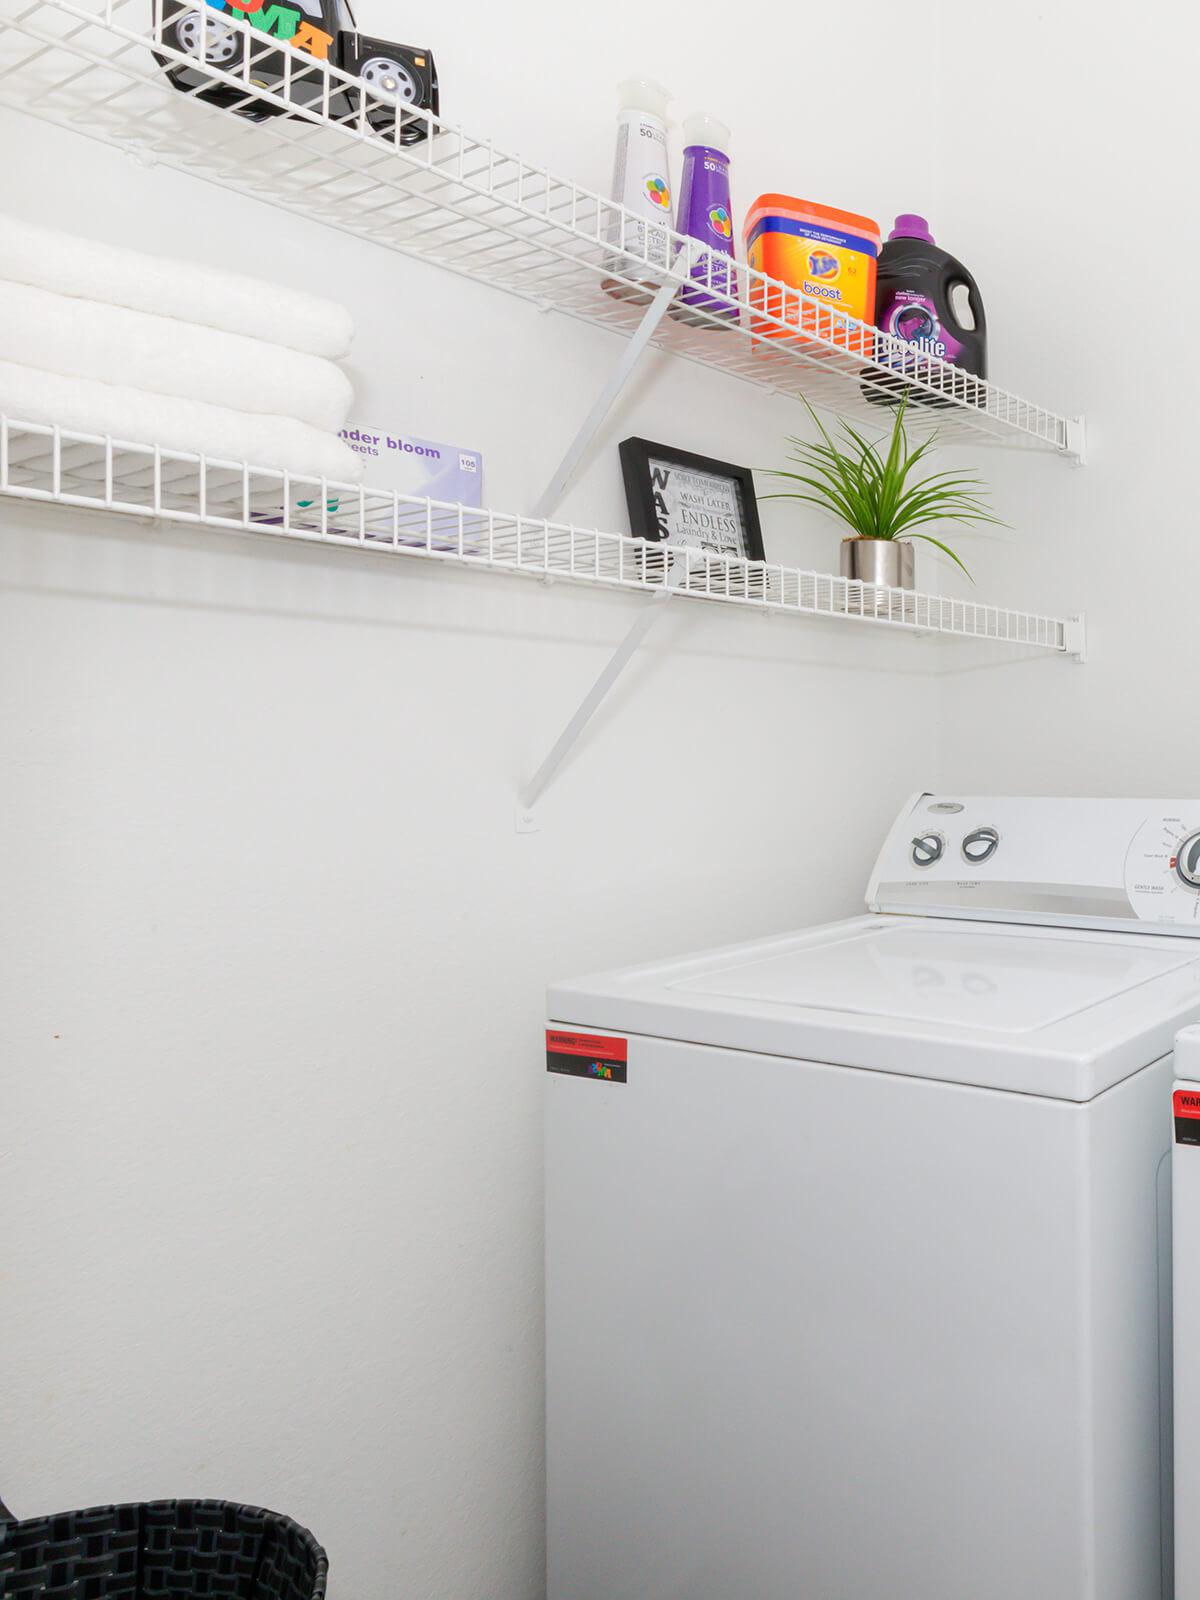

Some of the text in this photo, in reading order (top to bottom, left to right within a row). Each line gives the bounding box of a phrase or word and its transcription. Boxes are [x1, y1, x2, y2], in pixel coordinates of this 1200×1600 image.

[640, 128, 653, 138] 50
[704, 161, 716, 171] 50
[803, 280, 842, 300] boost
[337, 428, 441, 459] nder bloom
[347, 443, 379, 457] eets
[680, 491, 731, 512] WASH LATER
[681, 508, 737, 534] ENDLESS
[676, 522, 710, 541] Laundry
